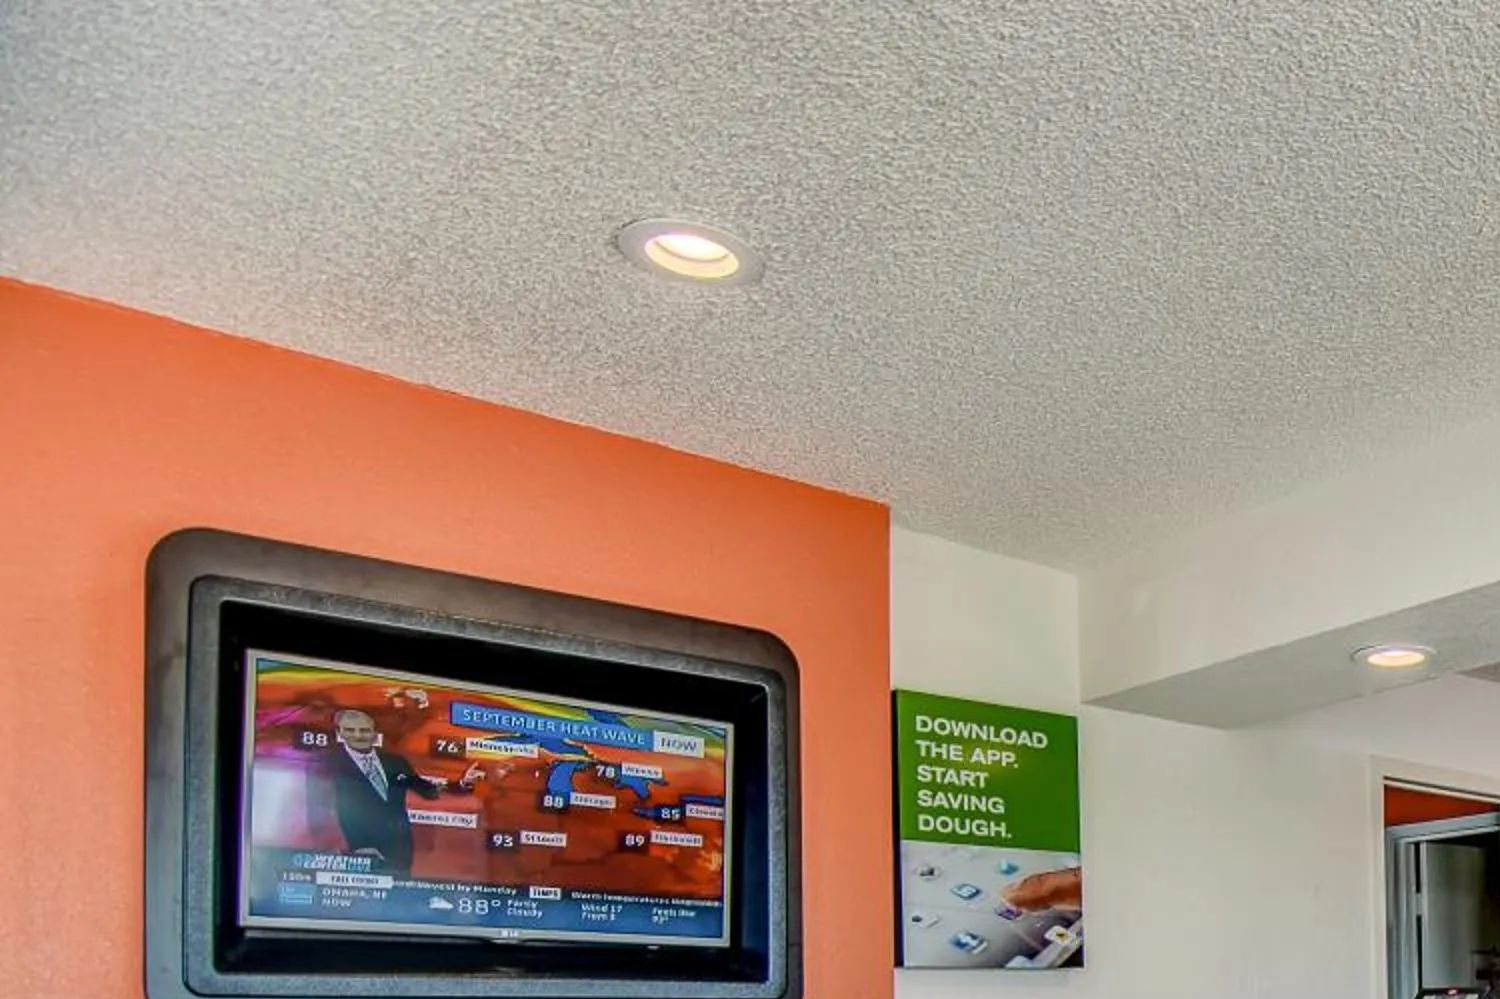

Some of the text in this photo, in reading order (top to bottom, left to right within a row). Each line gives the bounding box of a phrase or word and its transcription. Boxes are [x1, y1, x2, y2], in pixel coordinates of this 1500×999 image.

[463, 709, 645, 745] SEPTEMBER HEAT WAVE
[915, 715, 1048, 748] DOWNLOAD
[915, 740, 1019, 769] THE APP.
[917, 765, 989, 789] START
[917, 789, 1005, 815] SAVING
[918, 814, 1012, 838] DOUGH.
